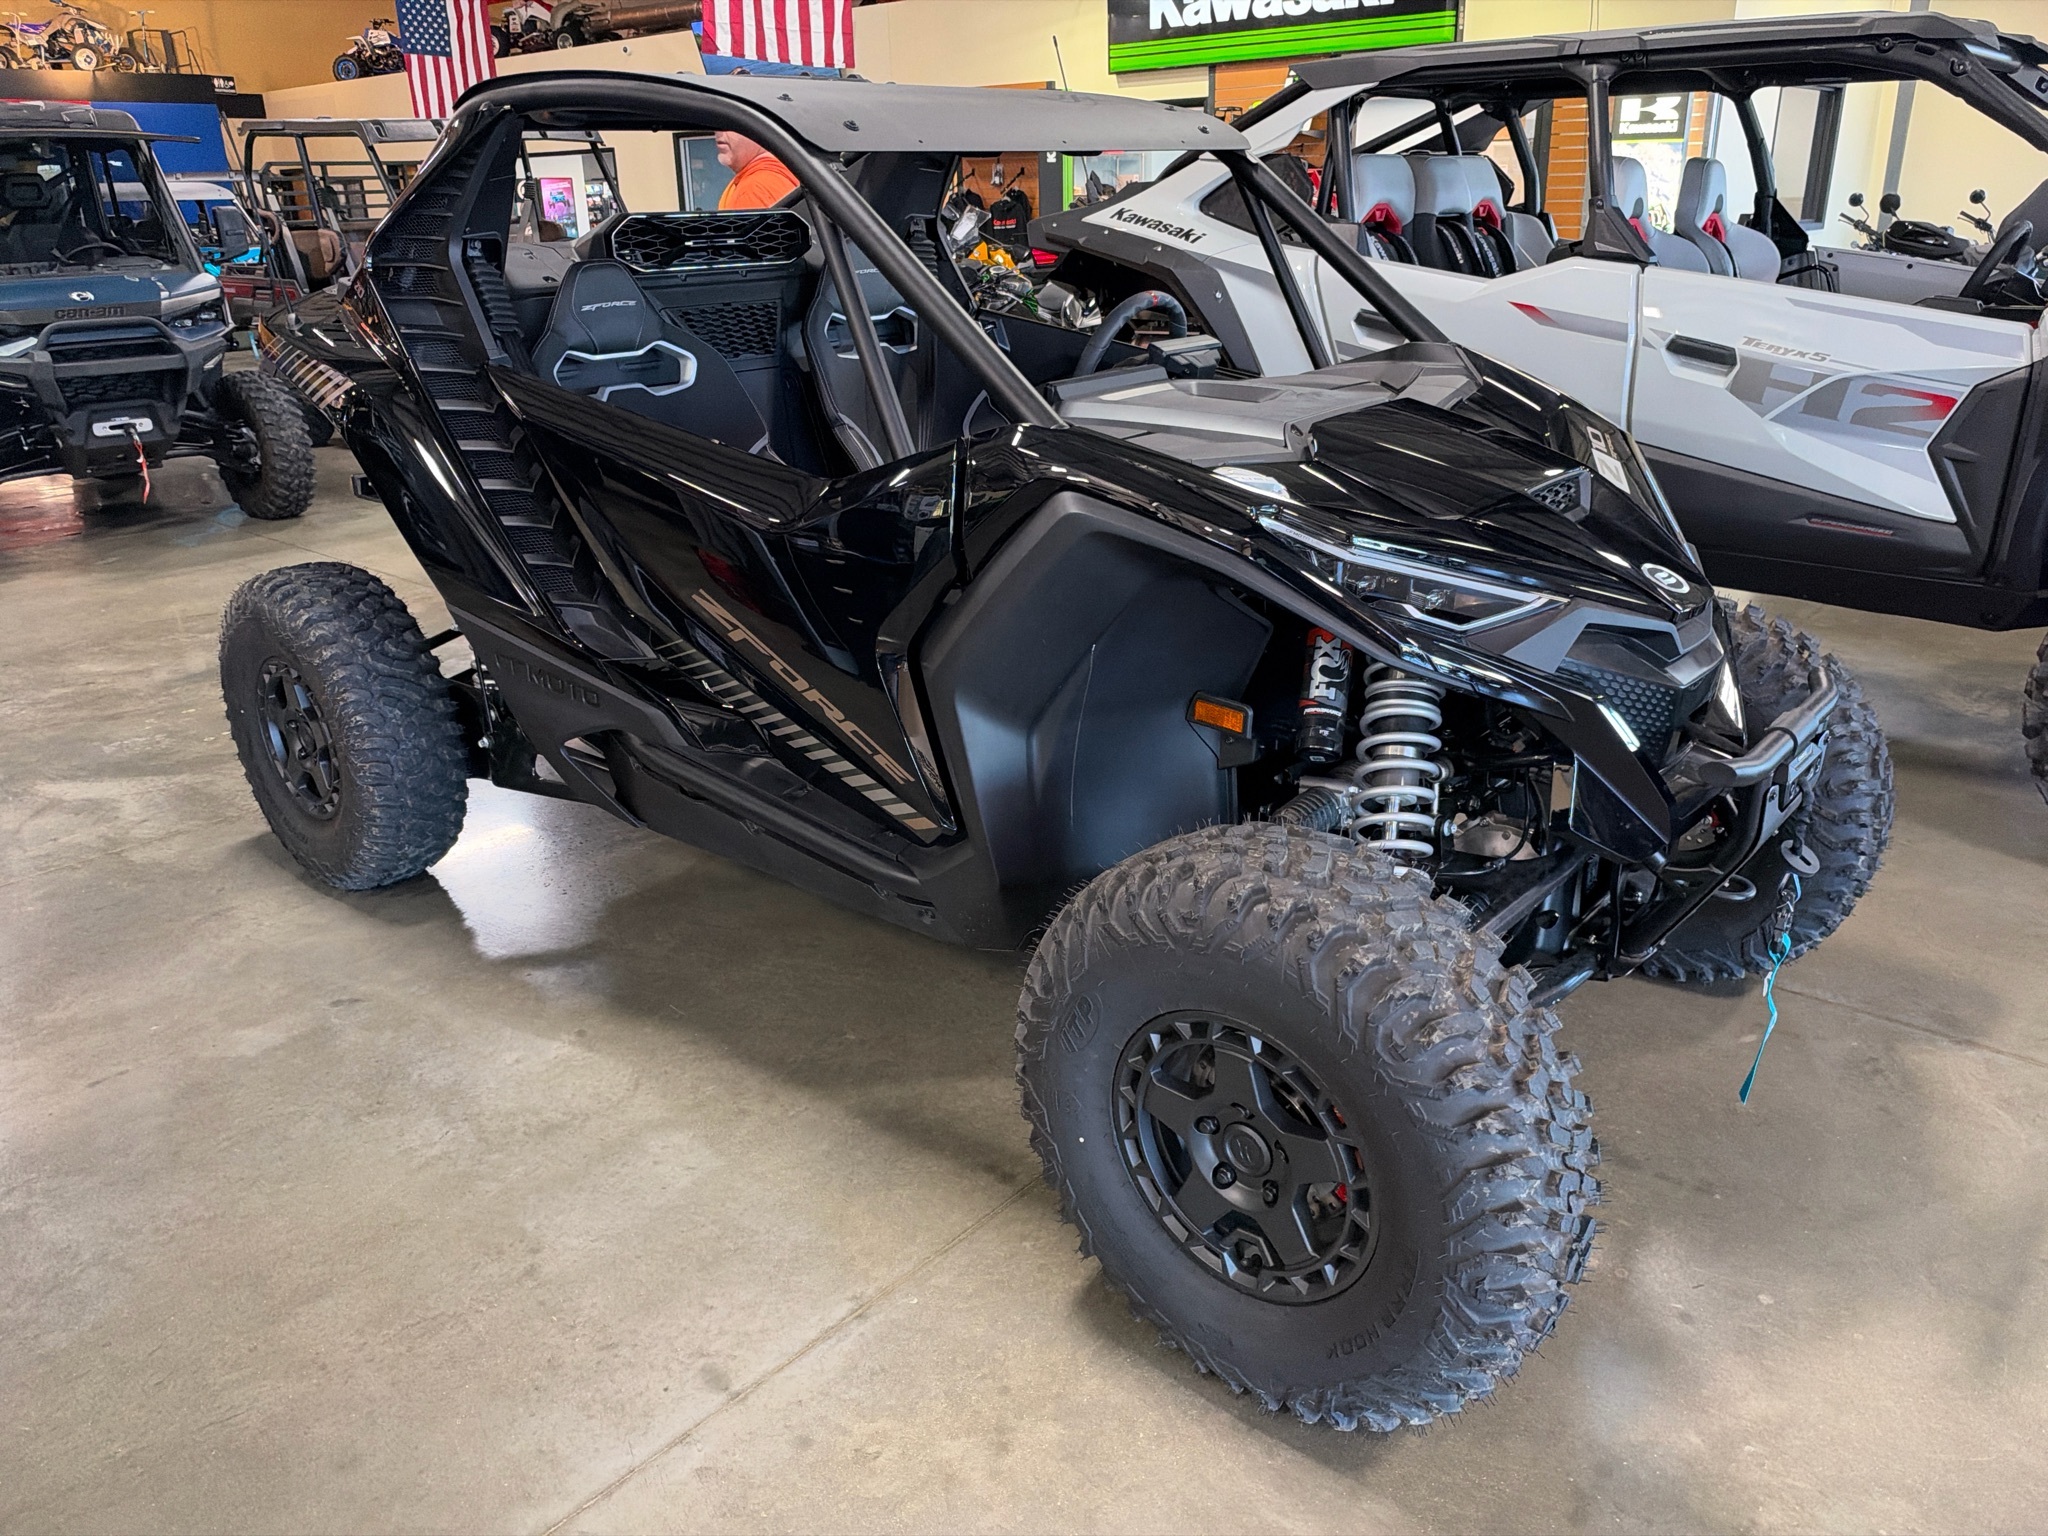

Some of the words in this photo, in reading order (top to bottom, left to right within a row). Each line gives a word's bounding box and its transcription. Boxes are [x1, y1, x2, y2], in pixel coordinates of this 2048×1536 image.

[1109, 207, 1207, 244] Kawasaki
[580, 300, 638, 312] ZFORCE
[691, 588, 916, 785] ZFORCE
[1308, 635, 1352, 701] FOX
